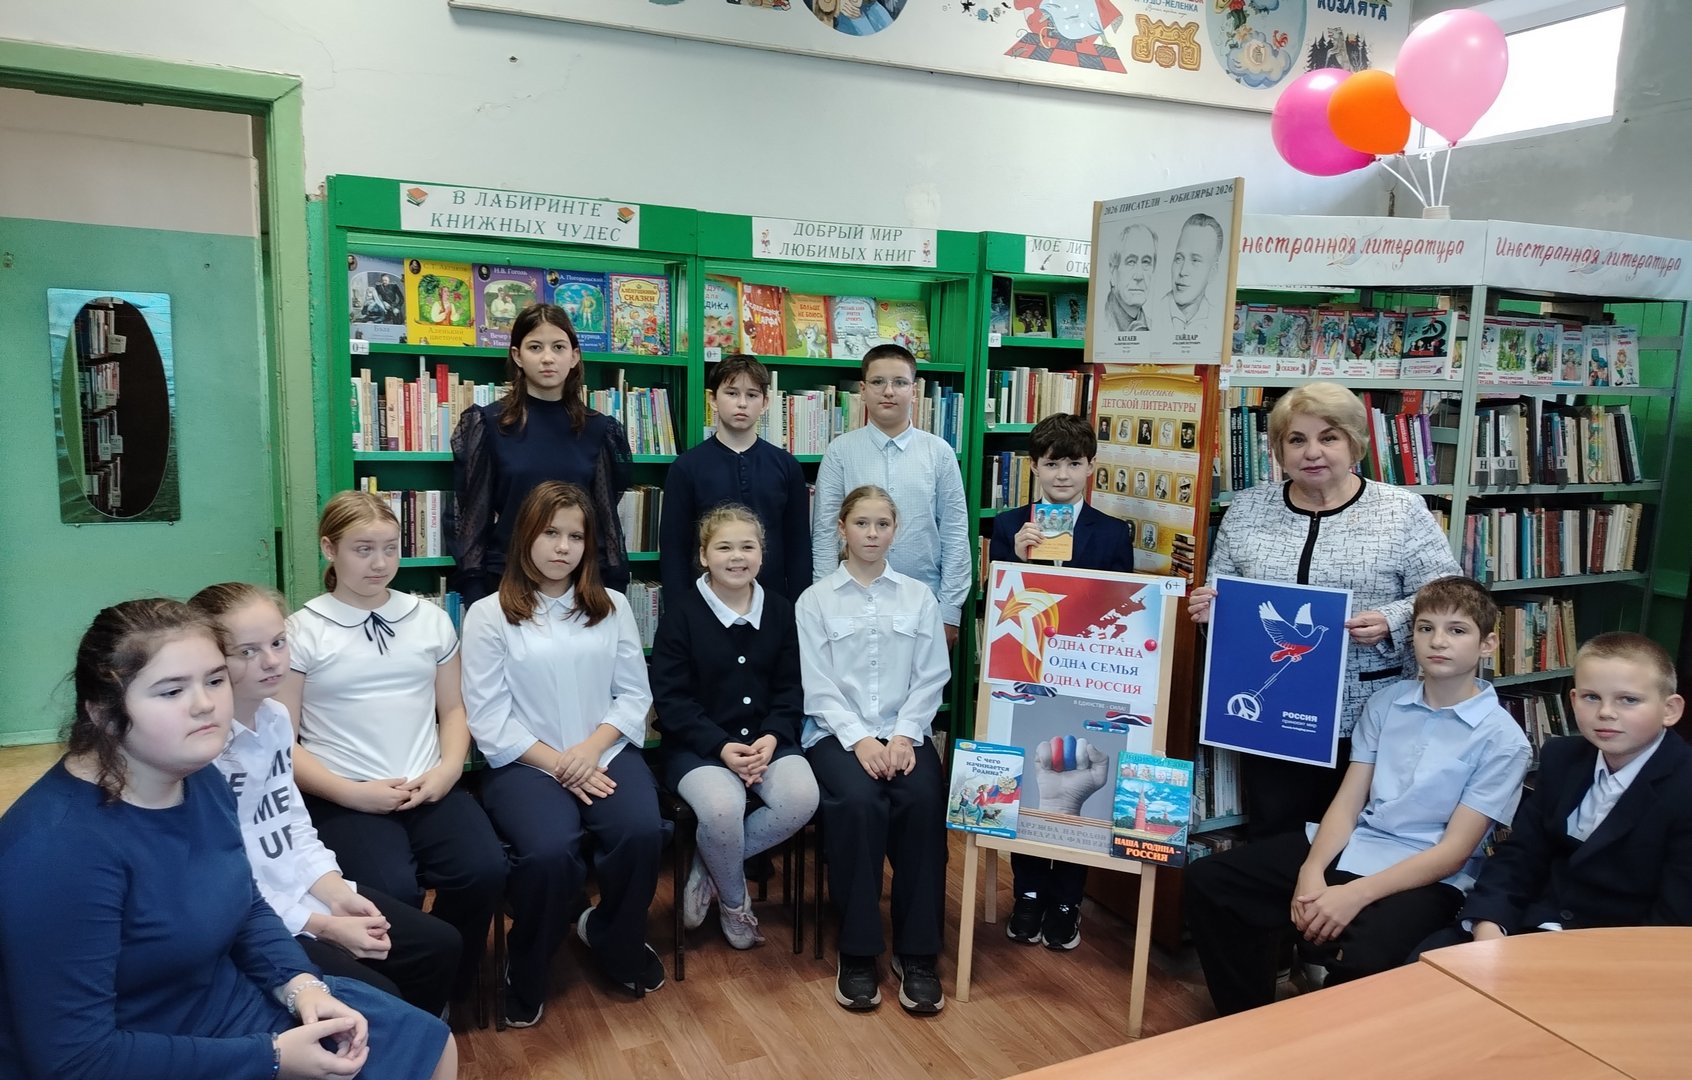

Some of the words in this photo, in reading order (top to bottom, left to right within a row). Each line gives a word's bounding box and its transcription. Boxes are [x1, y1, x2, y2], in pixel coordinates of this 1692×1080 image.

[452, 190, 466, 205] В
[476, 191, 602, 218] ЛАБИРИНТЕ
[1104, 204, 1118, 216] 2026
[1119, 197, 1160, 214] ПИСАТЕЛИ
[1169, 187, 1214, 205] ЮБИЛЯРЫ
[1215, 184, 1233, 196] 2026
[430, 213, 546, 235] КНИЖНЫХ
[556, 222, 622, 242] ЧУДЕС
[793, 222, 864, 240] ДОБРЫЙ
[870, 227, 903, 242] МИР
[779, 242, 866, 261] ЛЮБИМЫХ
[873, 248, 916, 262] КНИГ
[1240, 235, 1356, 262] ностранная
[1360, 237, 1465, 264] литература
[1496, 236, 1600, 266] Иностранная
[1602, 252, 1682, 278] литература
[623, 294, 656, 303] СКАЗКИ
[352, 343, 368, 352] 0+
[1122, 379, 1175, 398] Классики
[1100, 398, 1138, 410] ДЕТСКОЙ
[1140, 400, 1197, 413] ЛИТЕРАТУРЫ
[1480, 460, 1488, 469] Н
[1498, 458, 1504, 467] О
[1509, 460, 1516, 468] П
[1560, 459, 1566, 467] Р
[1485, 560, 1492, 568] С
[1165, 580, 1181, 590] 6+
[1048, 637, 1085, 652] ОДНА
[1089, 643, 1143, 659] СТРАНА
[1049, 656, 1086, 670] ОДНА
[1092, 662, 1138, 676] СЕМЬЯ
[1044, 672, 1080, 688] ОДНА
[1085, 678, 1142, 694] РОССИЯ
[1282, 710, 1318, 722] РОССИЯ
[966, 762, 1010, 772] начинается
[254, 786, 290, 825] ME
[1114, 837, 1140, 848] НАША
[1142, 842, 1174, 854] РОДИНА
[1126, 848, 1168, 862] РОССИЯ
